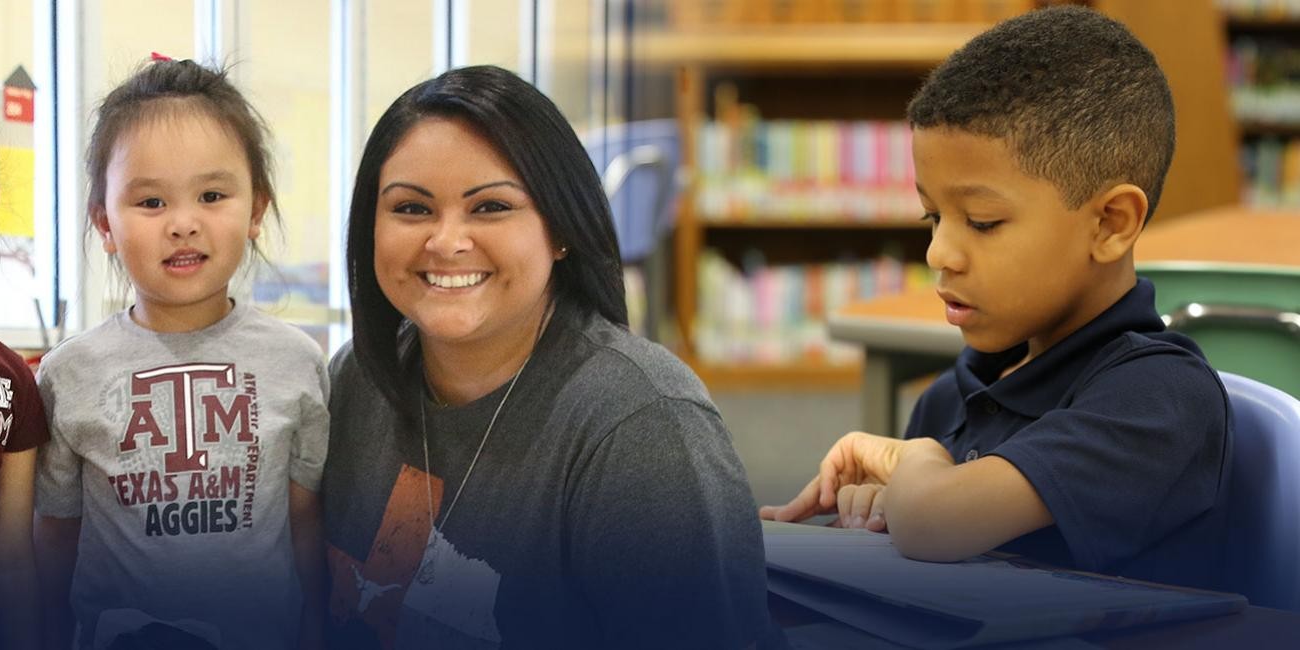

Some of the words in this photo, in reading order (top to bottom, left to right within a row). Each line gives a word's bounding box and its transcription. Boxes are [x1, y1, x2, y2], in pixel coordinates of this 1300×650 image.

[108, 470, 179, 507] TEXAS
[187, 466, 242, 500] A&M
[145, 500, 238, 537] AGGIES
